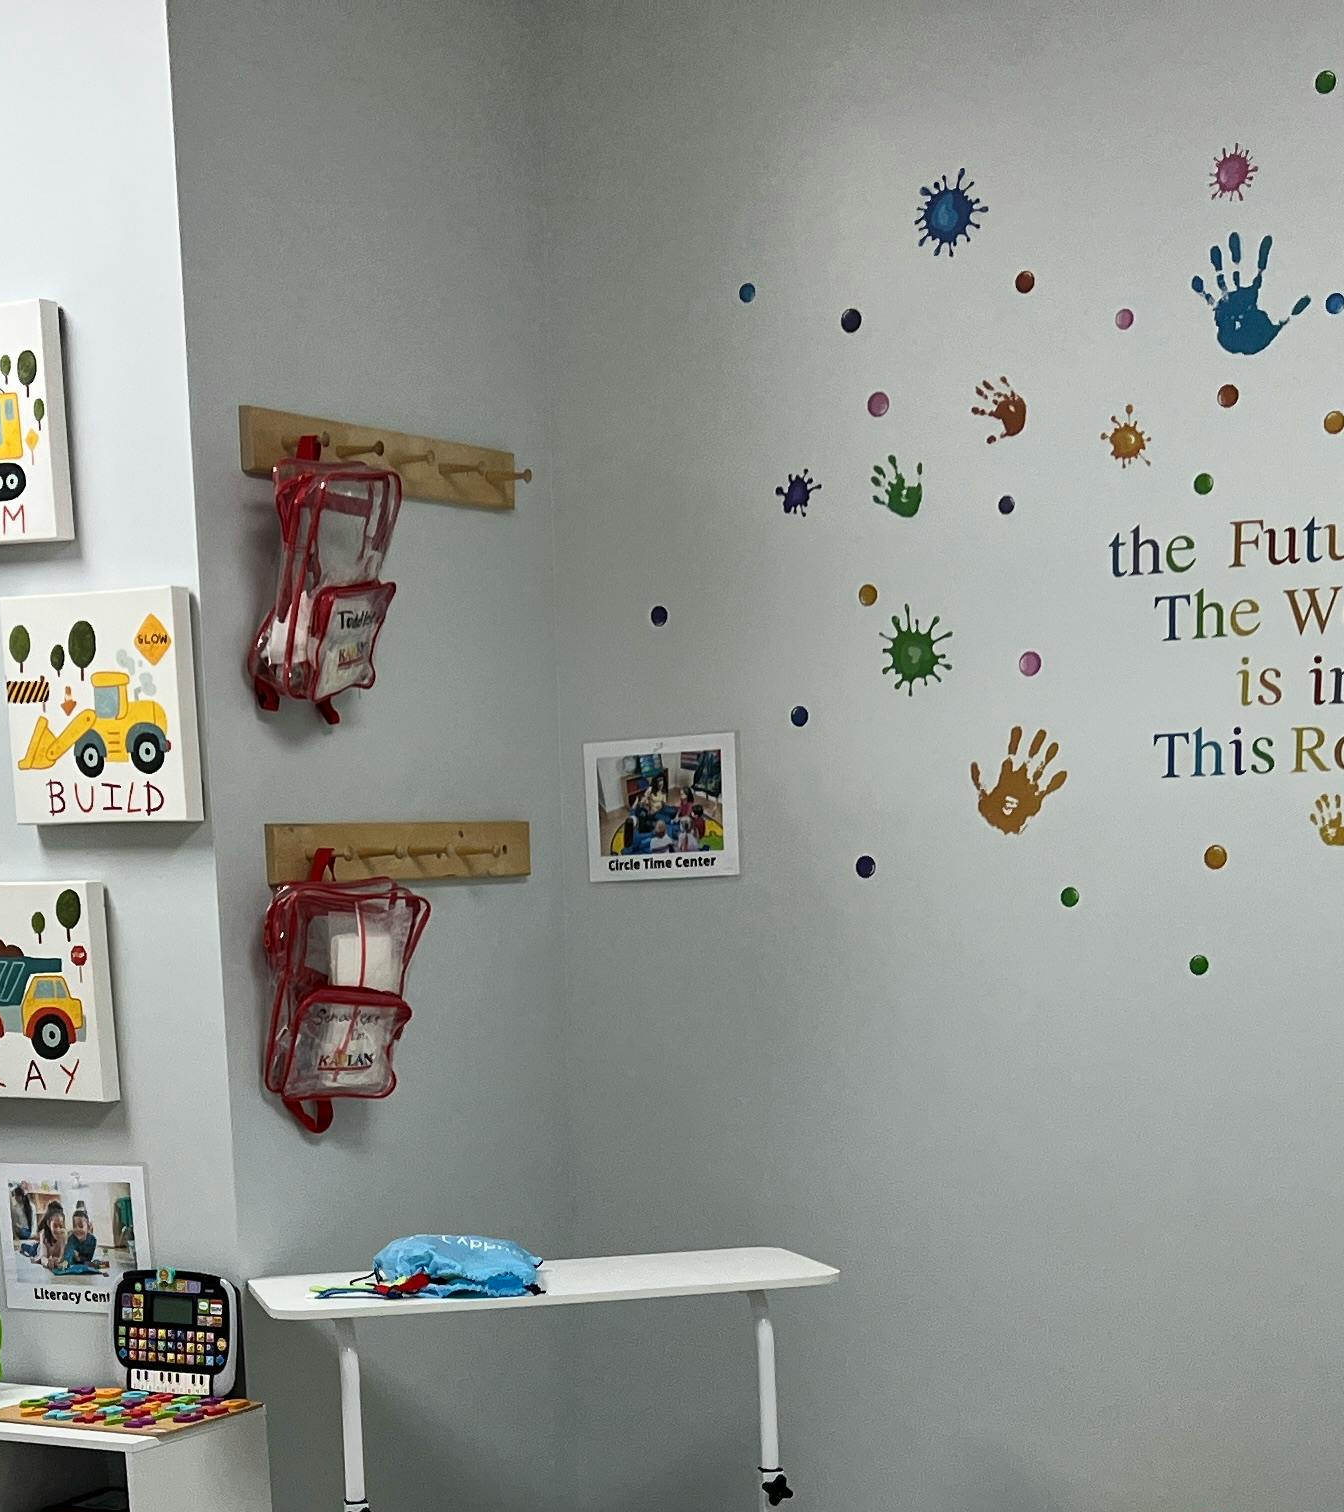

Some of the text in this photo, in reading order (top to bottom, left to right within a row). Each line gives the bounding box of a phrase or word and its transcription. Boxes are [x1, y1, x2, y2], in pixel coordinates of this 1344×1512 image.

[1109, 524, 1196, 577] the
[1154, 588, 1261, 641] The
[137, 632, 168, 646] SLOW
[1237, 656, 1283, 707] is
[1153, 727, 1276, 779] This
[46, 778, 165, 816] BUILD
[608, 856, 717, 871] Circle Time Center
[33, 1287, 81, 1304] Literacy
